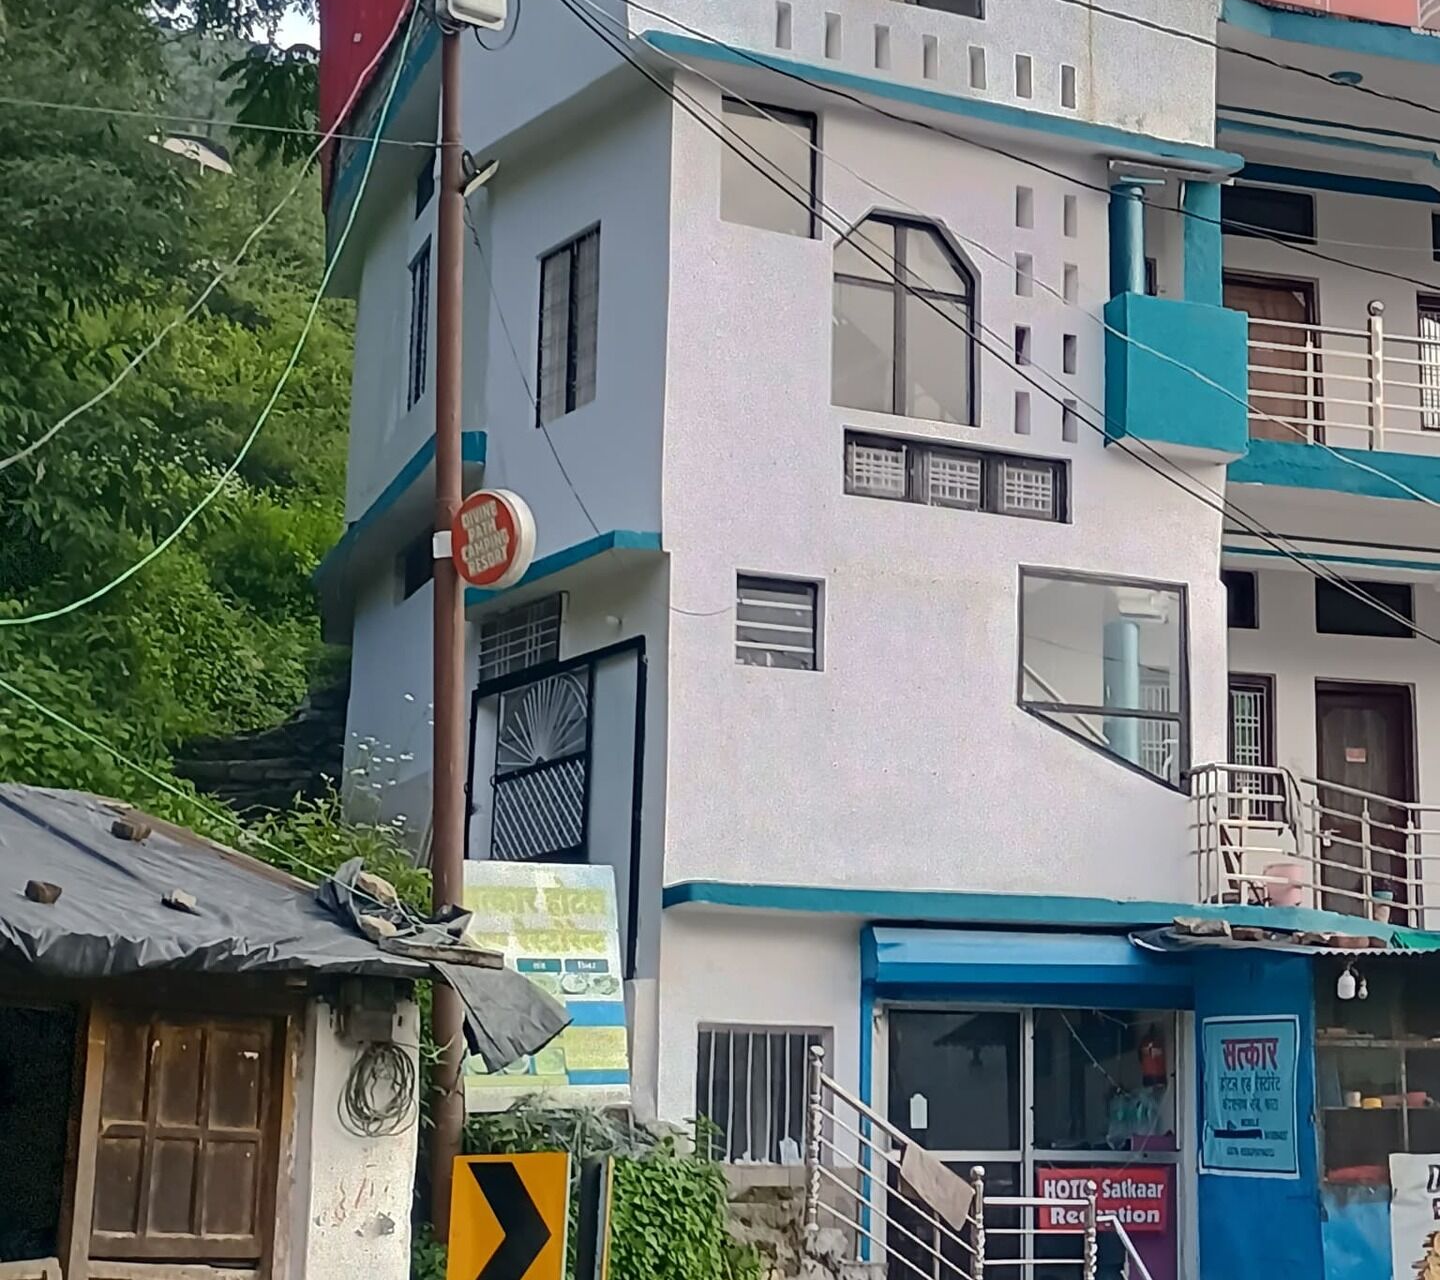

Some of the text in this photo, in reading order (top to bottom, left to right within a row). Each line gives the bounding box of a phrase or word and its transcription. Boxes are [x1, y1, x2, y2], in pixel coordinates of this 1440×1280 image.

[462, 501, 497, 528] DIVINE
[468, 519, 496, 542] PATH
[461, 529, 510, 562] CAMPING
[1221, 1037, 1279, 1071] सत्कार
[1102, 1179, 1164, 1198] Satkaar
